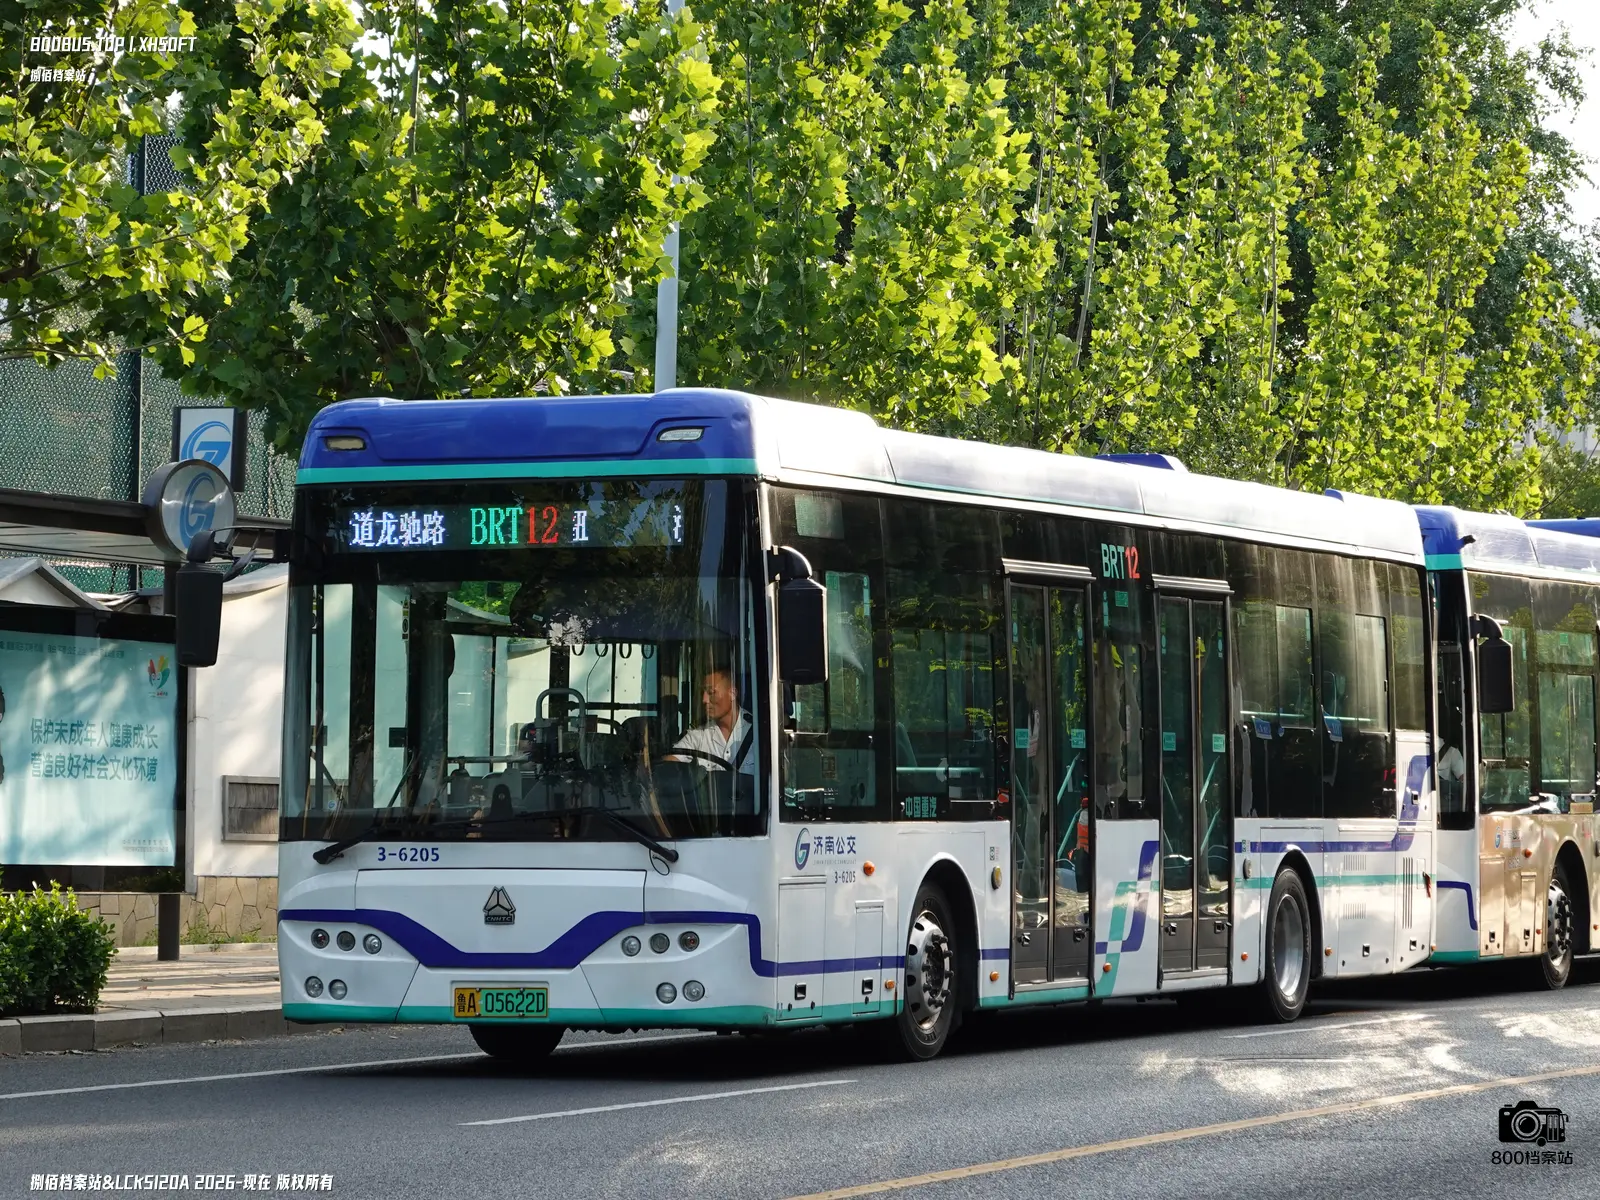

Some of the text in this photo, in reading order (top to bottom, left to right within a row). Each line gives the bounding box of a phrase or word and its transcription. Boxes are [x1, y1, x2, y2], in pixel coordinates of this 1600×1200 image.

[1101, 543, 1140, 579] BRT12
[31, 718, 158, 749] 保护未成年人健康成长
[31, 752, 158, 781] 营造良好社会文化环境
[905, 796, 937, 818] 中国重汽
[377, 847, 440, 862] 3-6205
[813, 835, 857, 855] 济南公交
[834, 870, 856, 884] 3-6205
